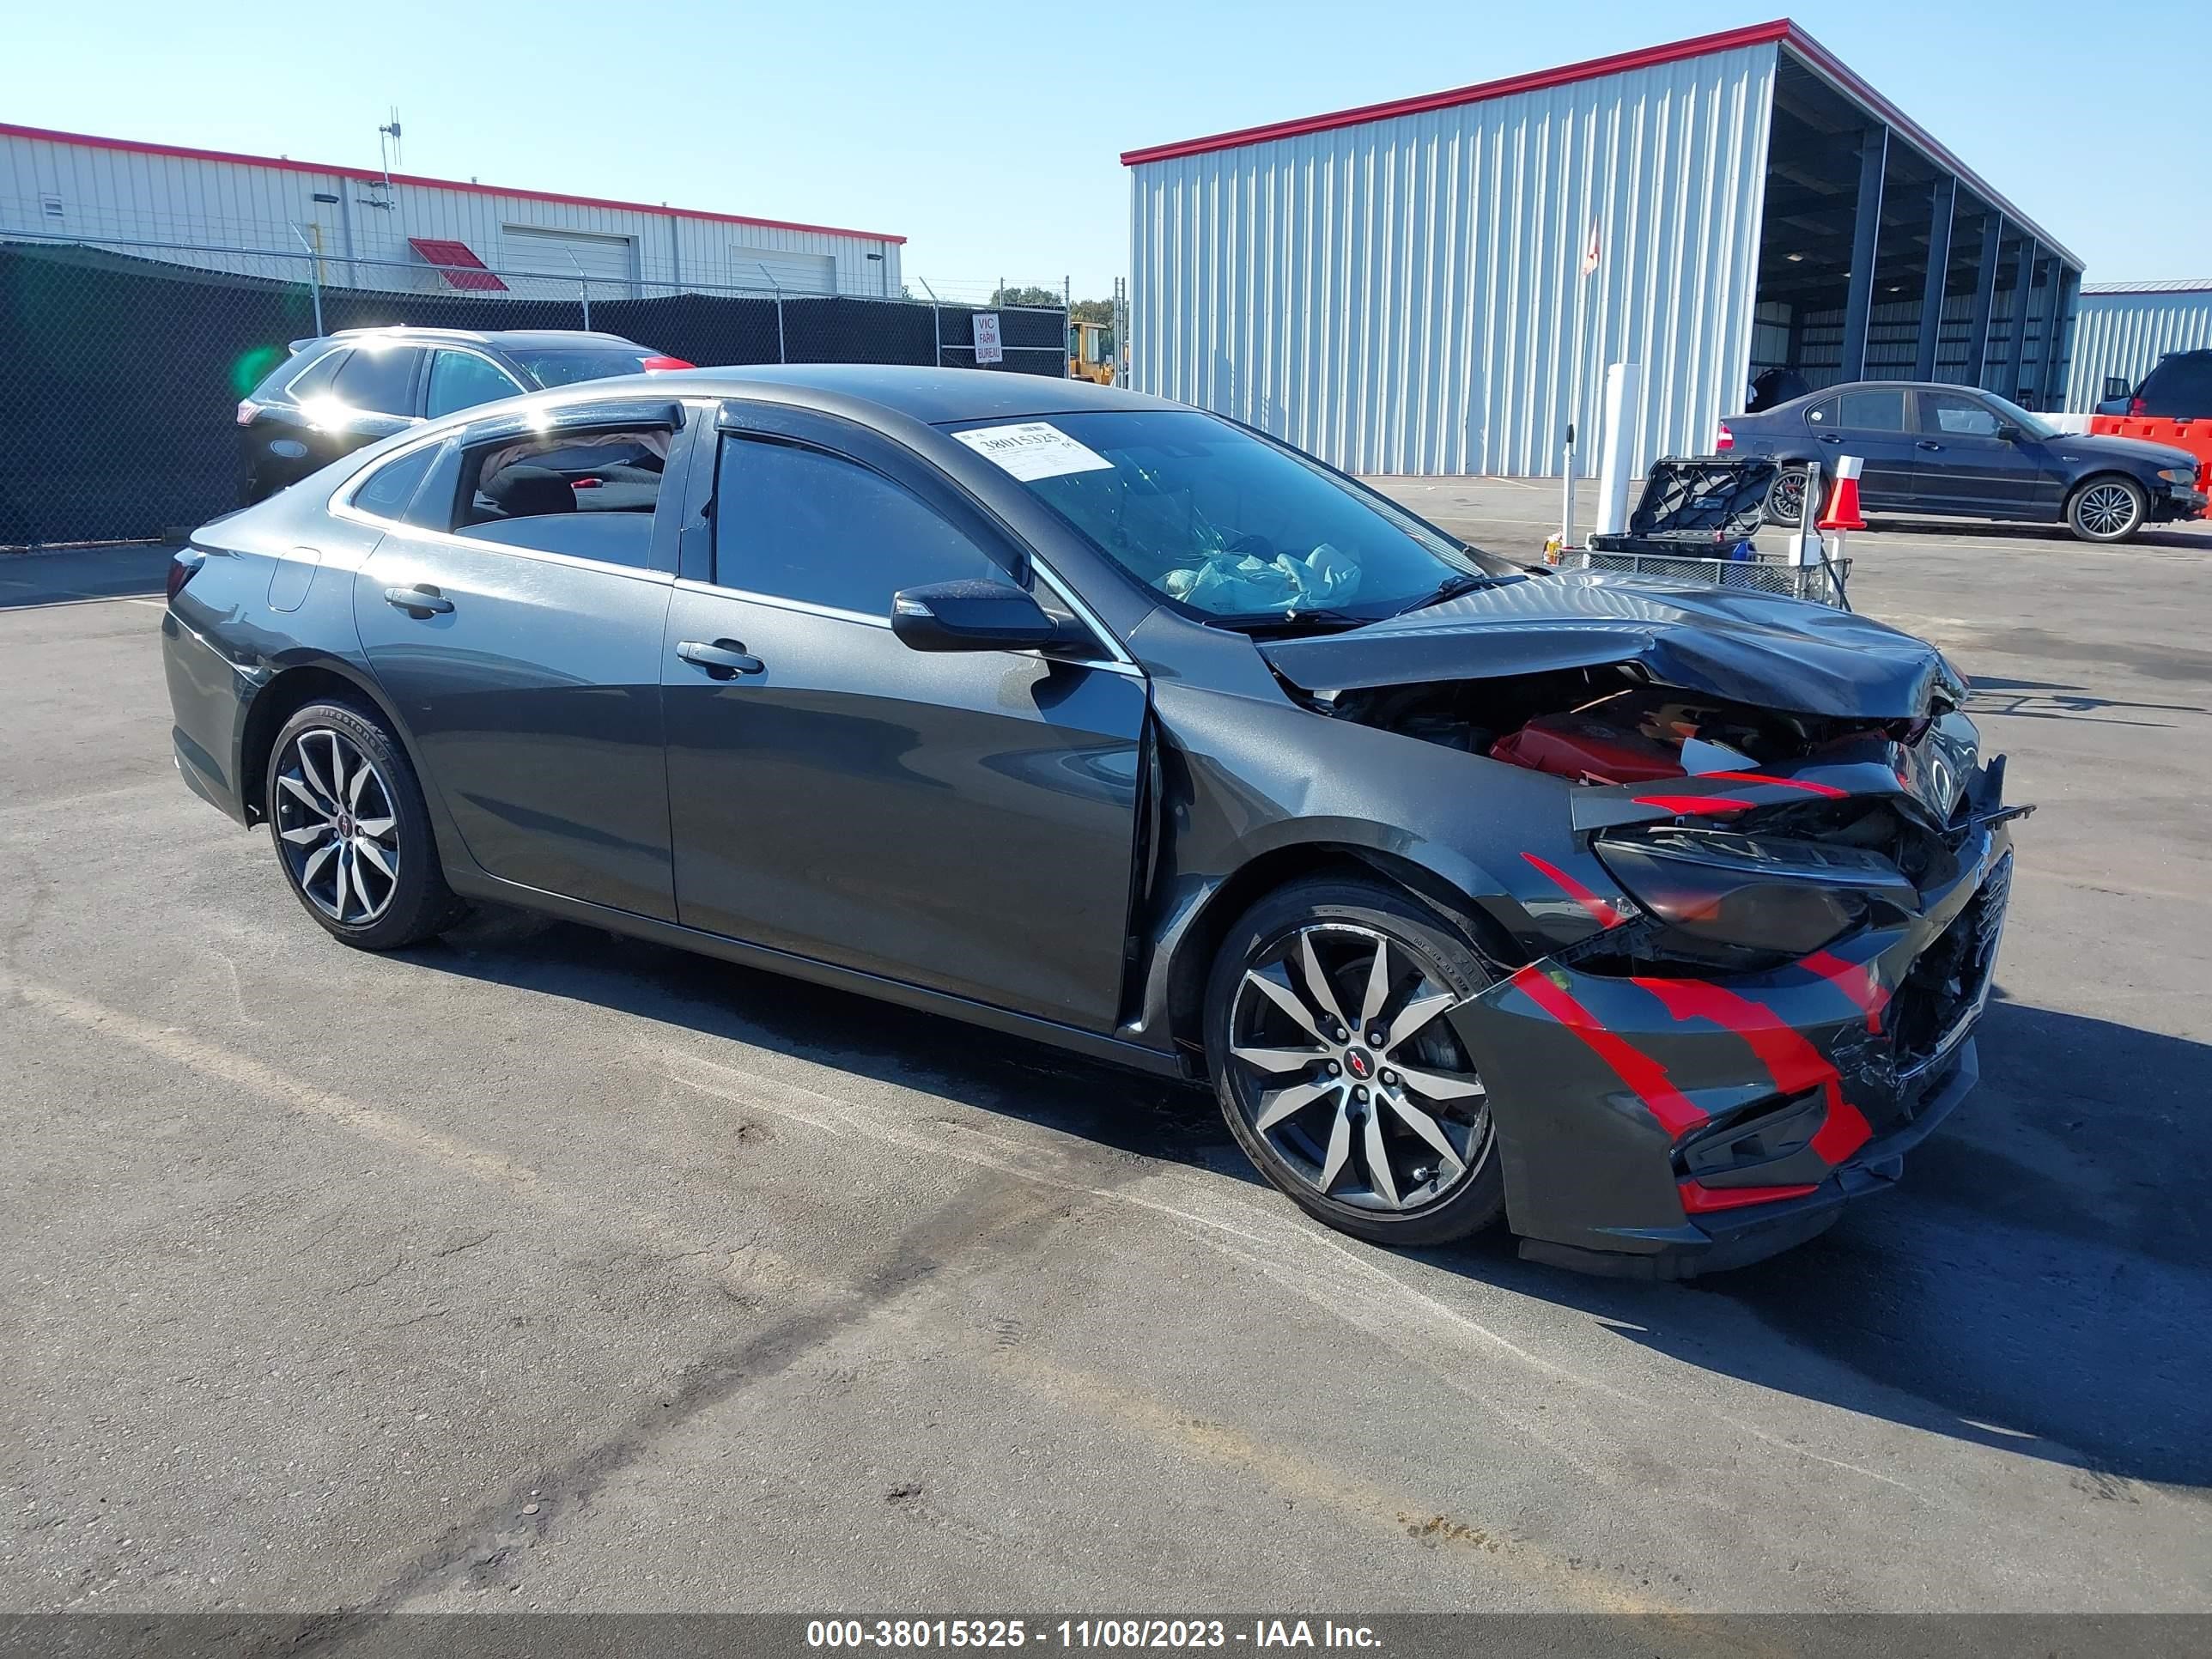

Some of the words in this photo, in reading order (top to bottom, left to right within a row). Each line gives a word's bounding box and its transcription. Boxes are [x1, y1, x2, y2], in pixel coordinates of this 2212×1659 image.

[978, 318, 994, 330] VIC
[979, 333, 996, 344] FARM
[977, 347, 1000, 359] BUREAU
[980, 434, 1061, 451] 38015325
